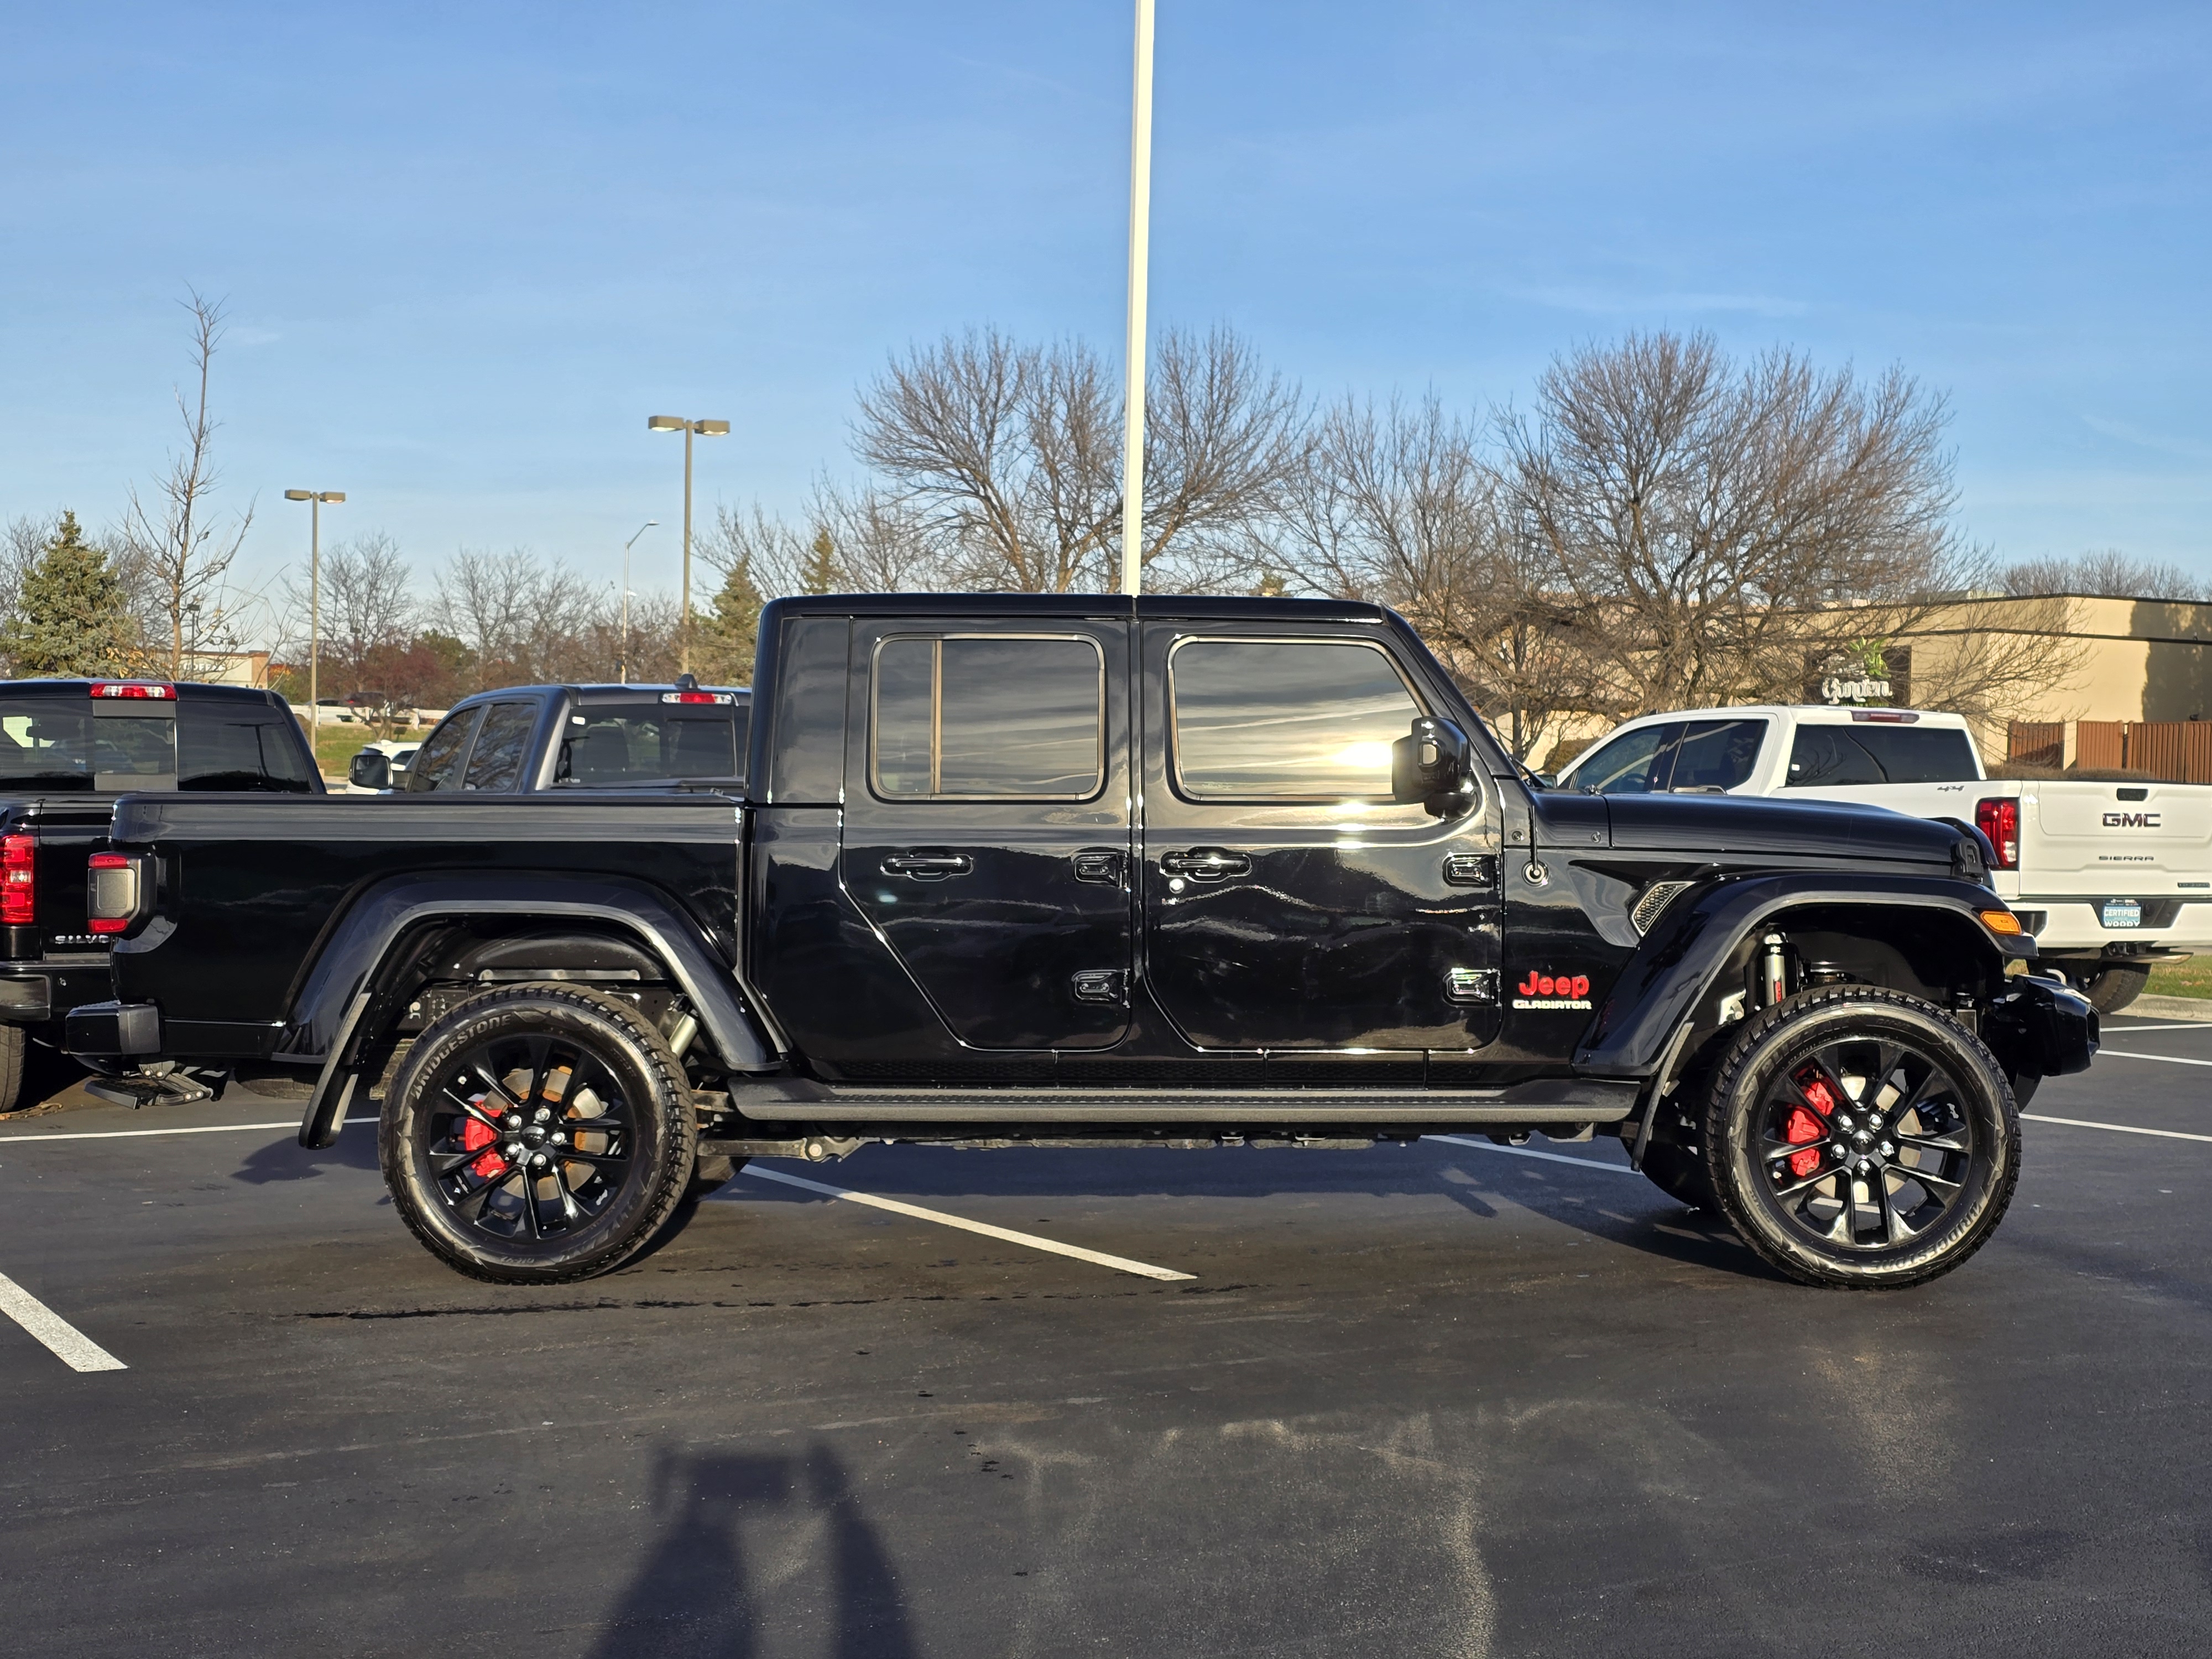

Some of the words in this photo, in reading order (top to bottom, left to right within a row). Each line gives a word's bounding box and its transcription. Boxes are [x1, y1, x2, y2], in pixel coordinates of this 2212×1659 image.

[2103, 813, 2161, 827] GMC
[2105, 909, 2140, 917] CERTIFIED
[1519, 971, 1590, 999] Jeep
[1512, 999, 1592, 1010] GLADIATOR
[410, 1014, 512, 1100] BRIDGESTONE
[1870, 1199, 1983, 1271] BRIDGESTONE
